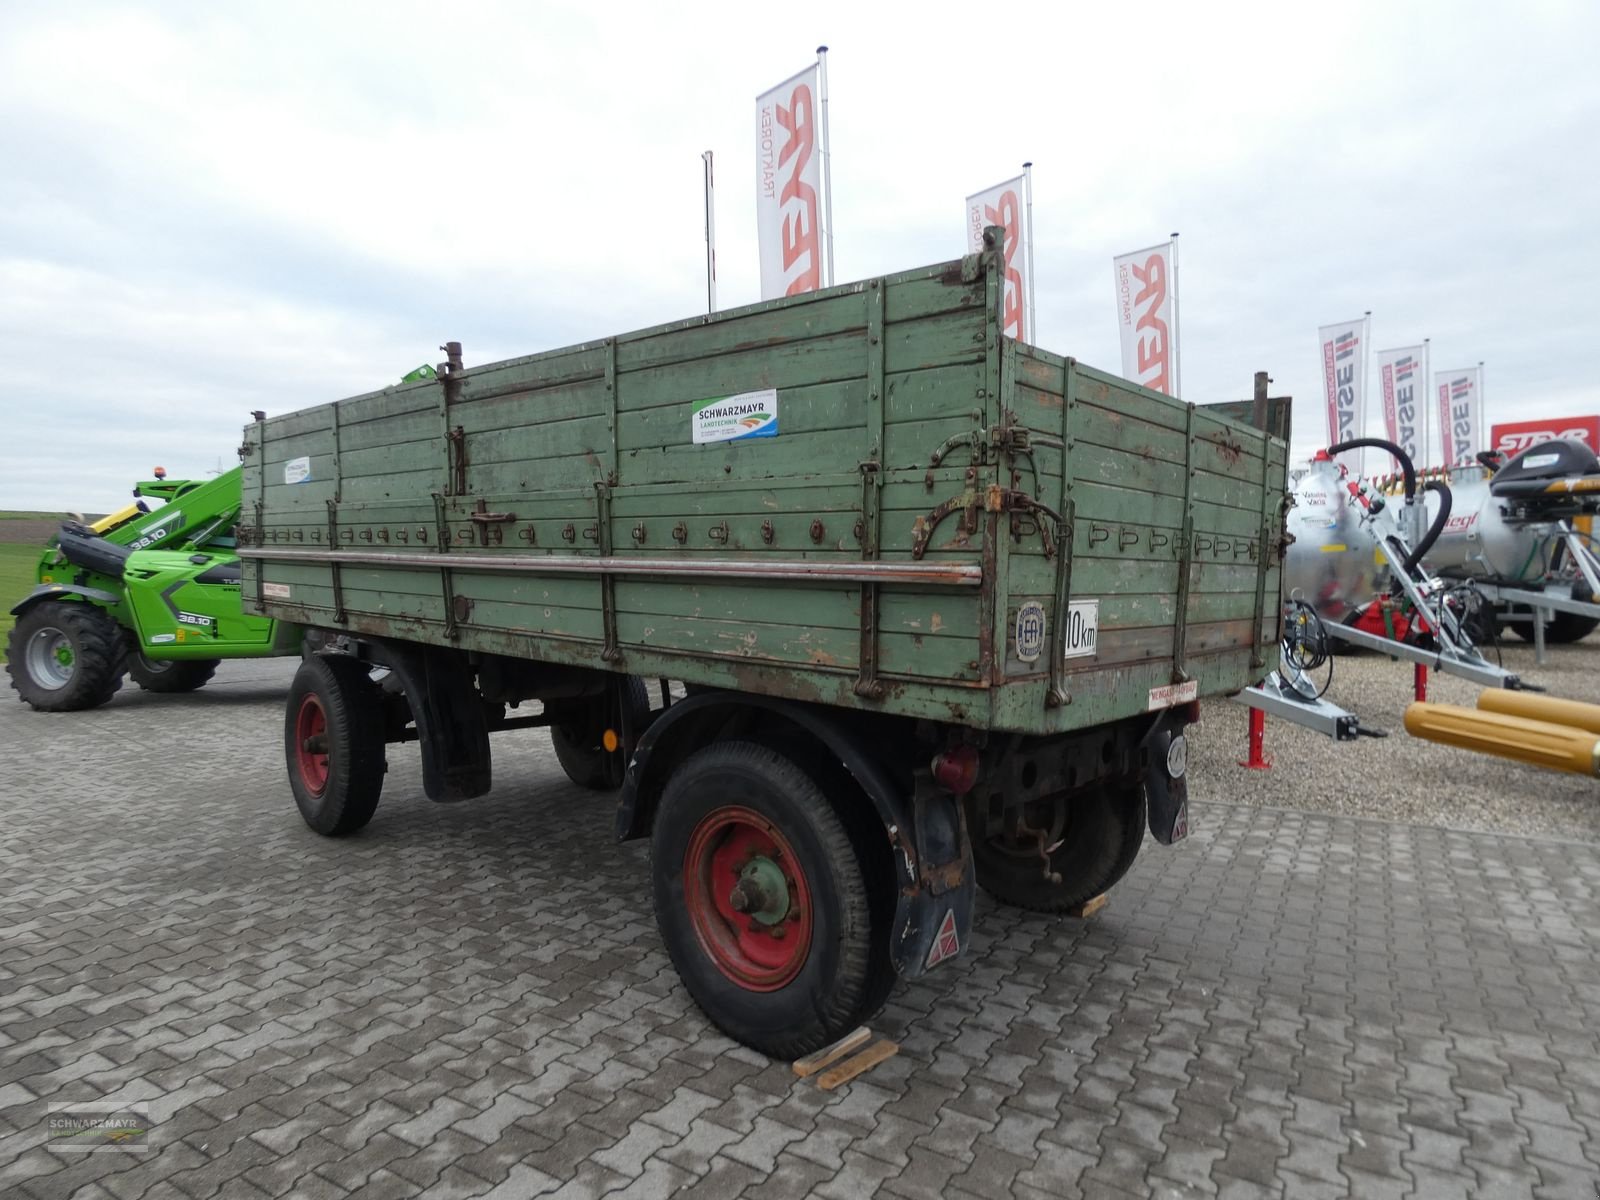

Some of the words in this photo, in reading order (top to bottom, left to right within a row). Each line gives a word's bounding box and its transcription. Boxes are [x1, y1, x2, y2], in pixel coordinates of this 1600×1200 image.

[699, 402, 764, 420] SCHWARZMAYR
[700, 418, 738, 429] LANDTECHNIK
[1444, 511, 1479, 529] iegl
[130, 528, 167, 550] 38.10
[179, 614, 210, 626] 38.10
[1082, 618, 1095, 648] km
